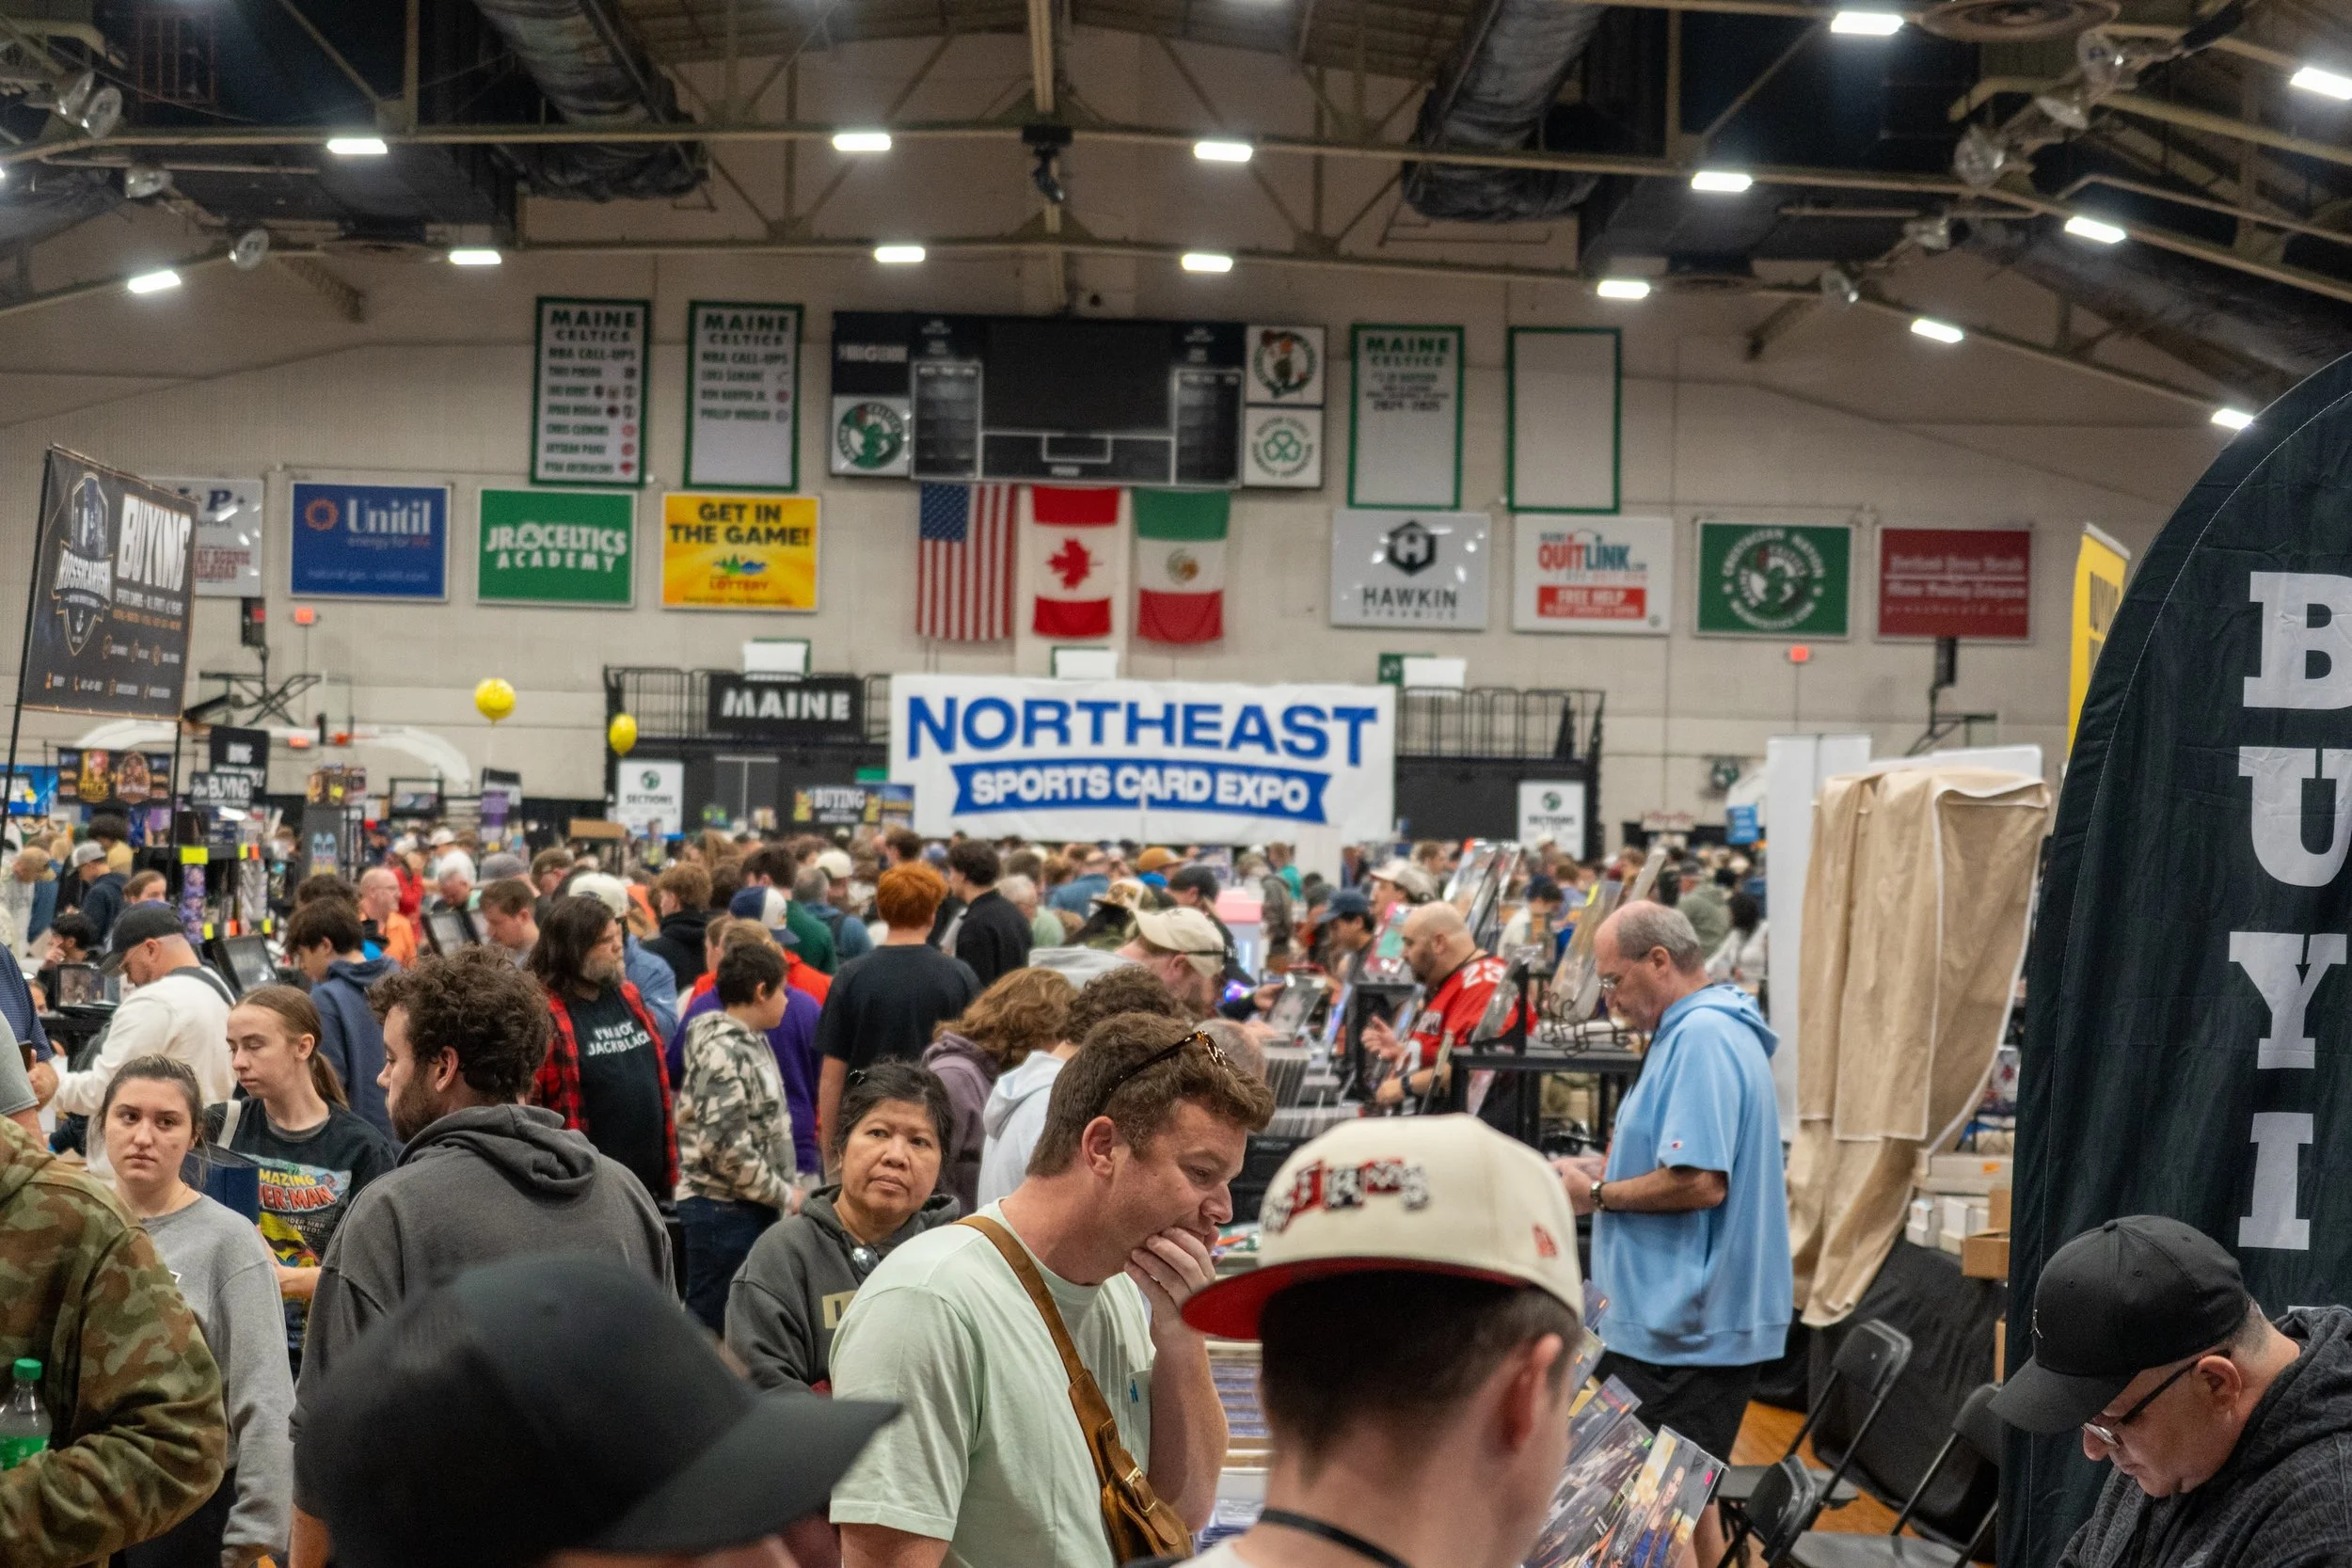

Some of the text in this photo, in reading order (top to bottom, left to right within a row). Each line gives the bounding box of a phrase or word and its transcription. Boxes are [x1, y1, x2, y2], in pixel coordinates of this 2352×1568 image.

[550, 309, 635, 327] MAINE
[705, 314, 788, 331] MAINE
[556, 330, 630, 341] CELTICS
[708, 334, 783, 345] CELTICS
[1366, 338, 1448, 353] MAINE
[347, 499, 431, 535] Unitil
[698, 502, 782, 524] GET IN
[117, 494, 191, 592] BUYING
[543, 525, 627, 555] CELTICS
[670, 524, 810, 546] THE GAME!
[497, 551, 615, 573] ACADEMY
[709, 578, 770, 592] LOTTERY
[1362, 587, 1456, 608] HAWKIN
[723, 689, 850, 721] MAINE
[907, 695, 1378, 768] NORTHEAST
[814, 788, 865, 810] BUYING
[971, 765, 1311, 813] SPORTS CARD EXPO
[2229, 571, 2352, 1317] BUYI
[259, 1168, 317, 1187] MAZING
